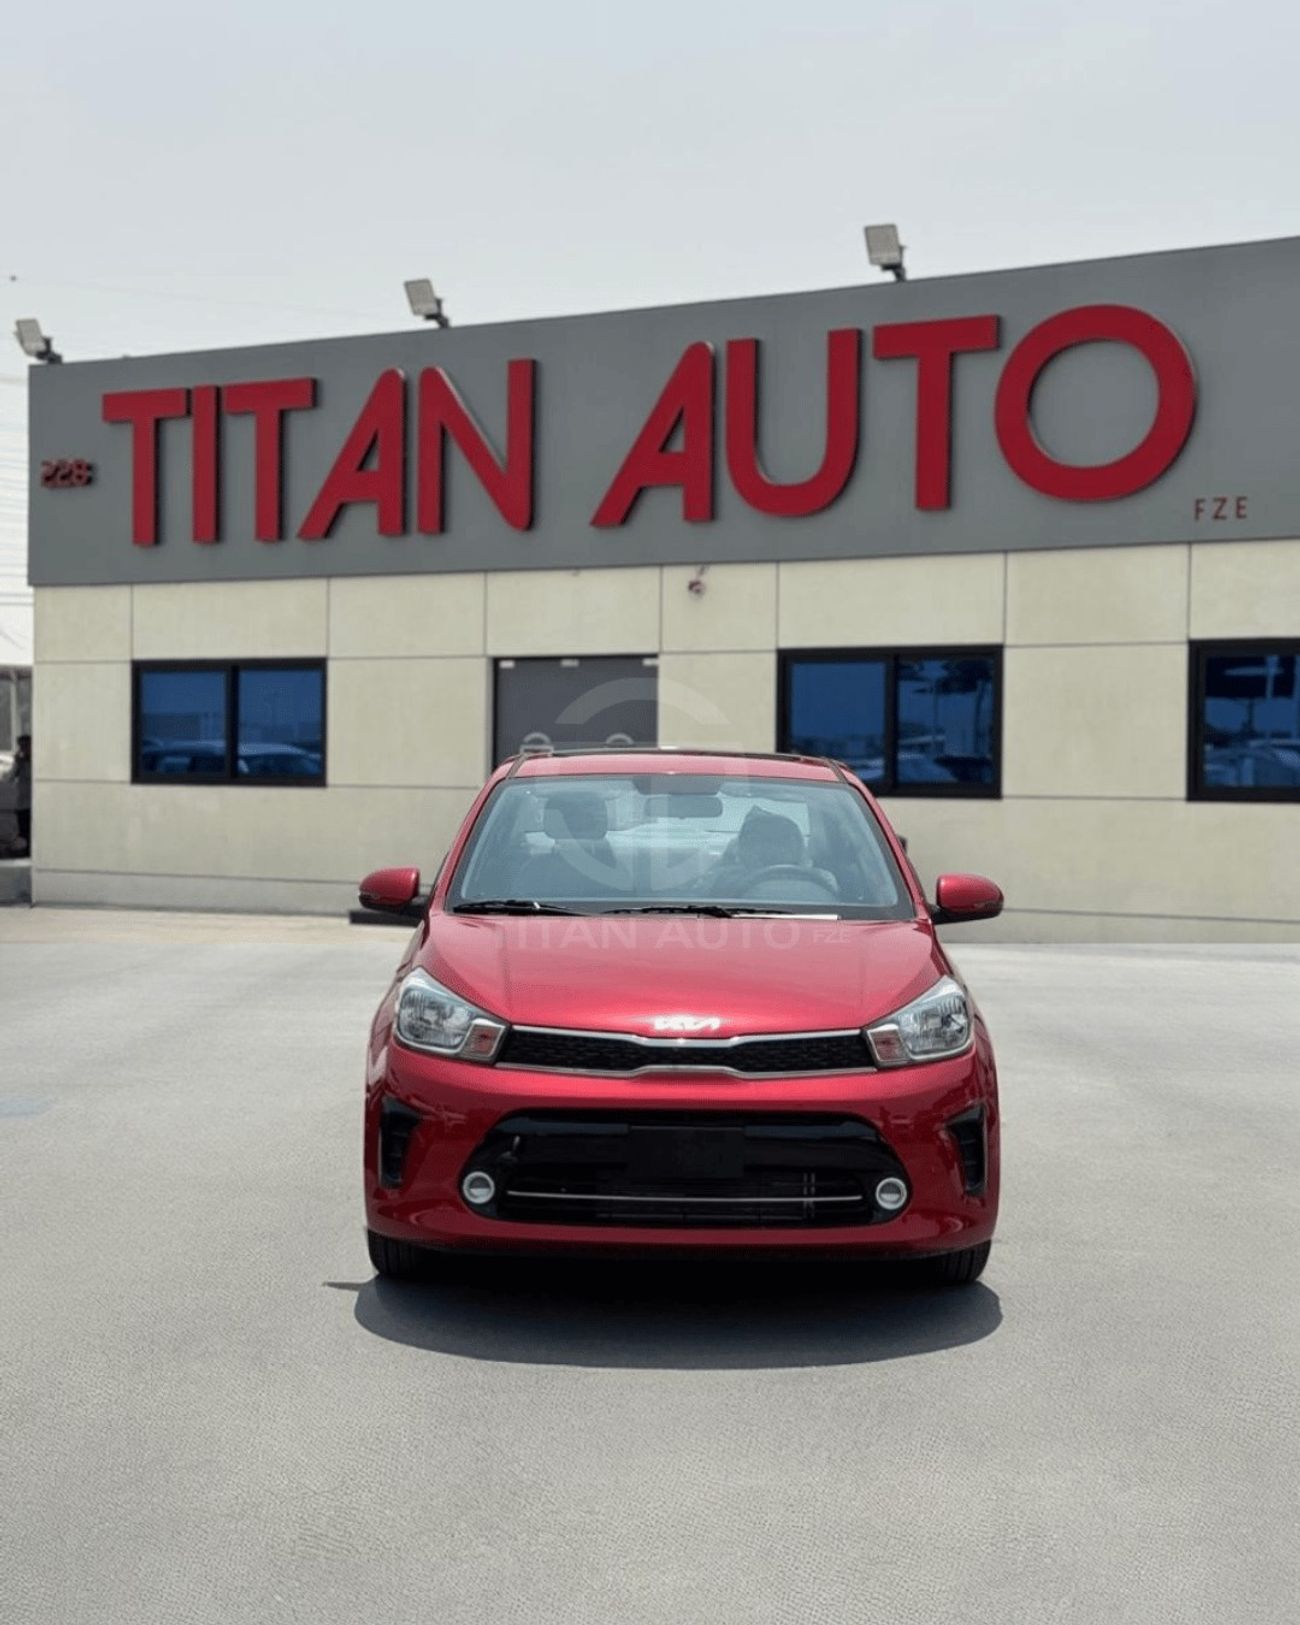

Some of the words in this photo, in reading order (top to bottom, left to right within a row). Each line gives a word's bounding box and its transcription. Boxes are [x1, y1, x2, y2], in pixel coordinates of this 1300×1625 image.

[102, 359, 536, 547] TITAN
[591, 304, 1197, 527] AUTO
[41, 459, 93, 489] 228
[1194, 496, 1249, 522] FZE
